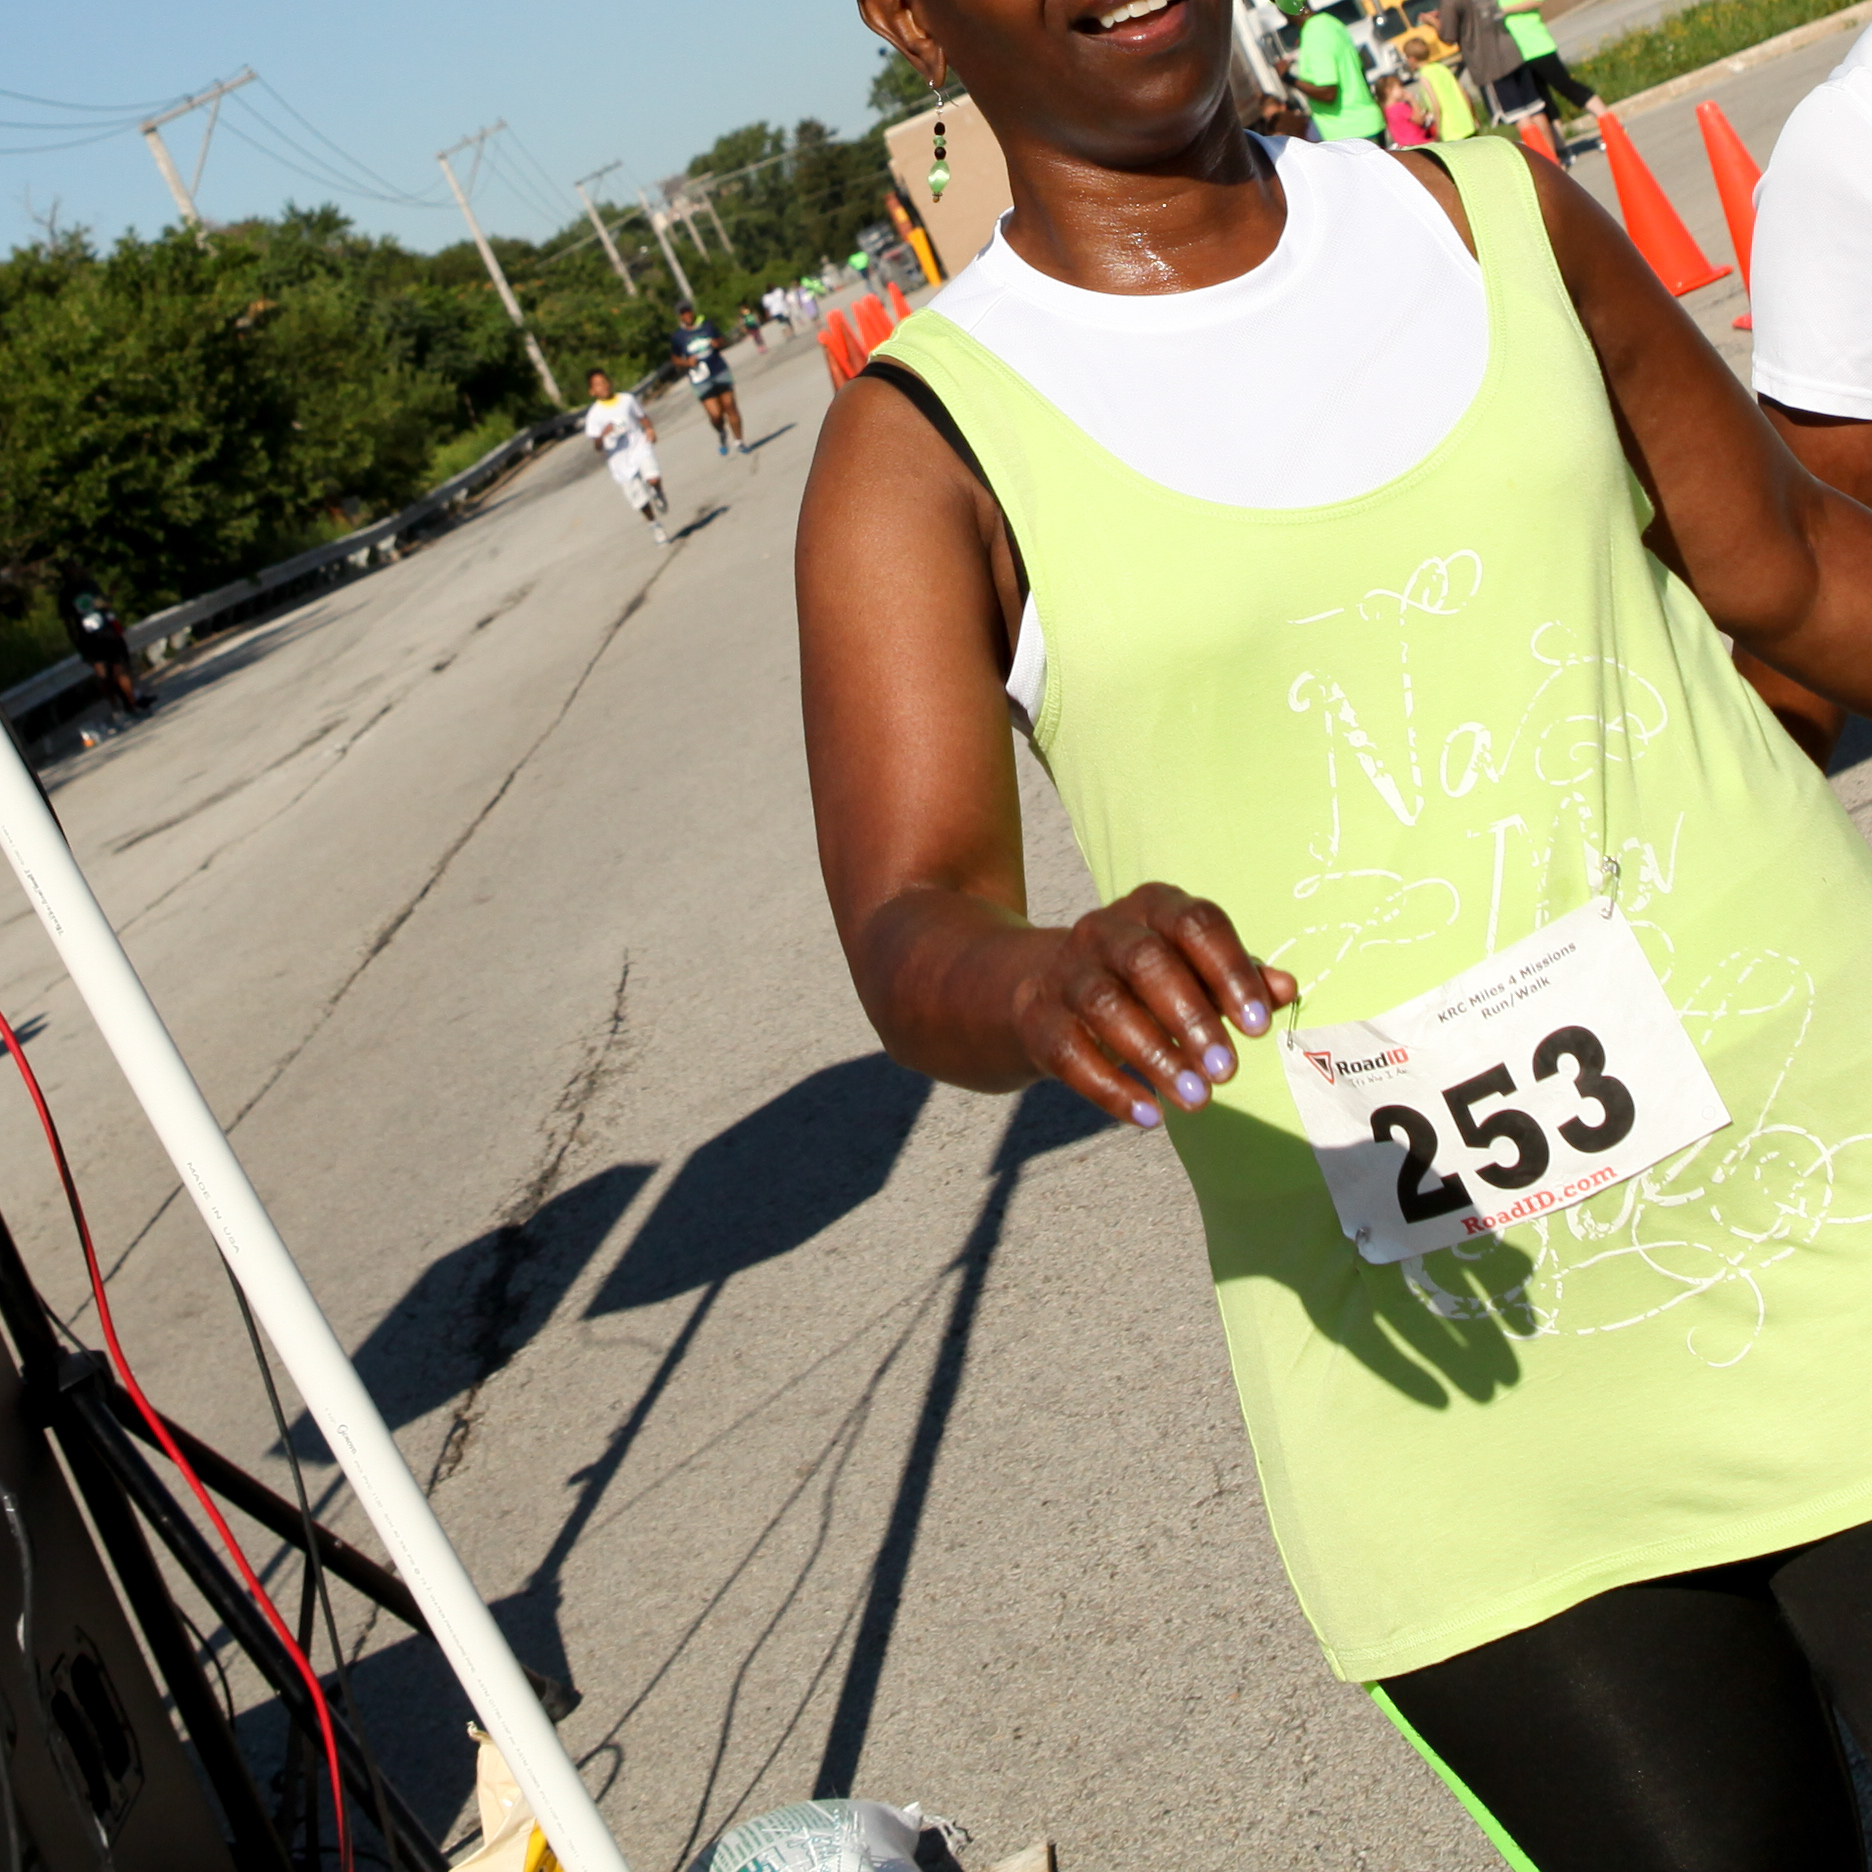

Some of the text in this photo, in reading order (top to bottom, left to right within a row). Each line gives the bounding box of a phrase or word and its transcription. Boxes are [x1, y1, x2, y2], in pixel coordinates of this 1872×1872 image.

[1437, 941, 1577, 1024] KRC Miles 4 Missions
[1481, 974, 1551, 1021] Run/Walk
[1335, 1047, 1409, 1077] RoadID
[1370, 1025, 1636, 1224] 253
[1460, 1165, 1618, 1235] RoadID.com
